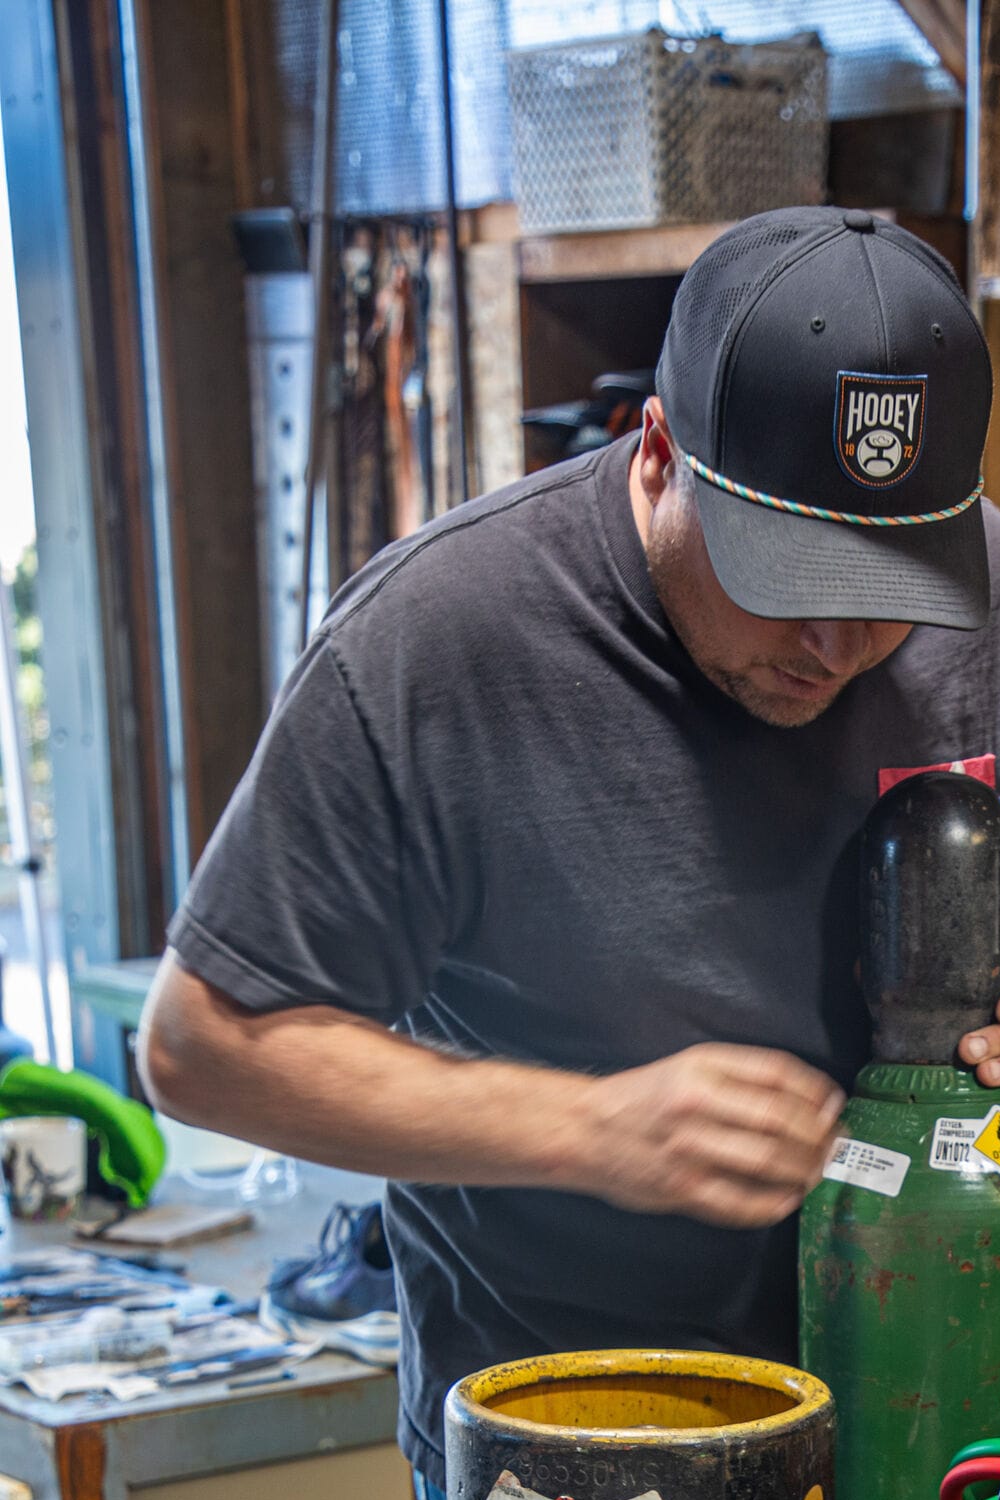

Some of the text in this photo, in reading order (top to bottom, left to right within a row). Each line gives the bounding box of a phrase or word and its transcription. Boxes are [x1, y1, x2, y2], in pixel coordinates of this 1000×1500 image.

[847, 390, 920, 442] HOOEY
[845, 443, 913, 458] 18 72
[935, 1140, 970, 1162] UN1072
